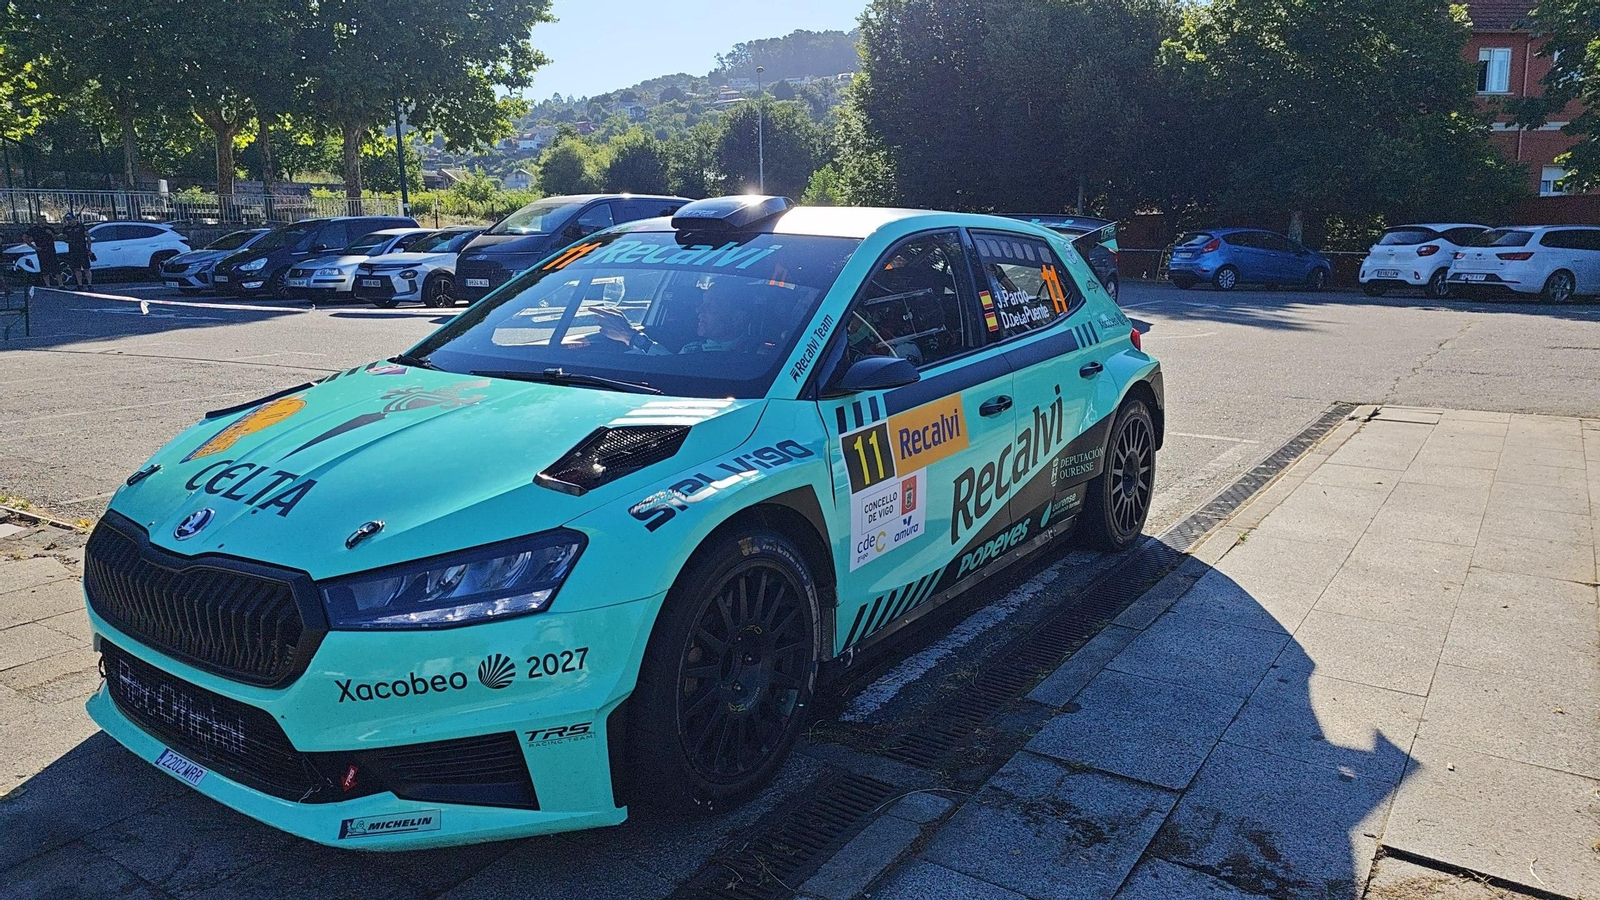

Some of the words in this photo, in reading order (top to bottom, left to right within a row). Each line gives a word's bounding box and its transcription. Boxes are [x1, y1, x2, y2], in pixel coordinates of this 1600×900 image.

[542, 242, 602, 271] 11
[584, 241, 783, 270] Recalvi
[1041, 264, 1068, 314] 11
[795, 335, 820, 376] Recalvi
[815, 314, 835, 340] Team
[898, 408, 961, 461] Recalvi
[853, 430, 885, 486] 11
[951, 384, 1063, 546] Recalvi
[1060, 446, 1104, 468] DEPUTACIÓN
[1060, 462, 1095, 480] OURENSE
[185, 459, 318, 517] CELTA
[864, 491, 898, 514] CONCELLO
[868, 512, 877, 524] DE
[878, 505, 894, 519] VIGO
[894, 523, 919, 542] amura
[334, 669, 468, 704] Xacobeo
[526, 647, 590, 679] 2027
[524, 721, 593, 742] TRS
[568, 734, 593, 742] TEAM
[162, 754, 187, 774] 2202
[183, 763, 204, 783] MRR
[344, 767, 355, 787] TRS
[367, 816, 433, 831] MICHELIN
